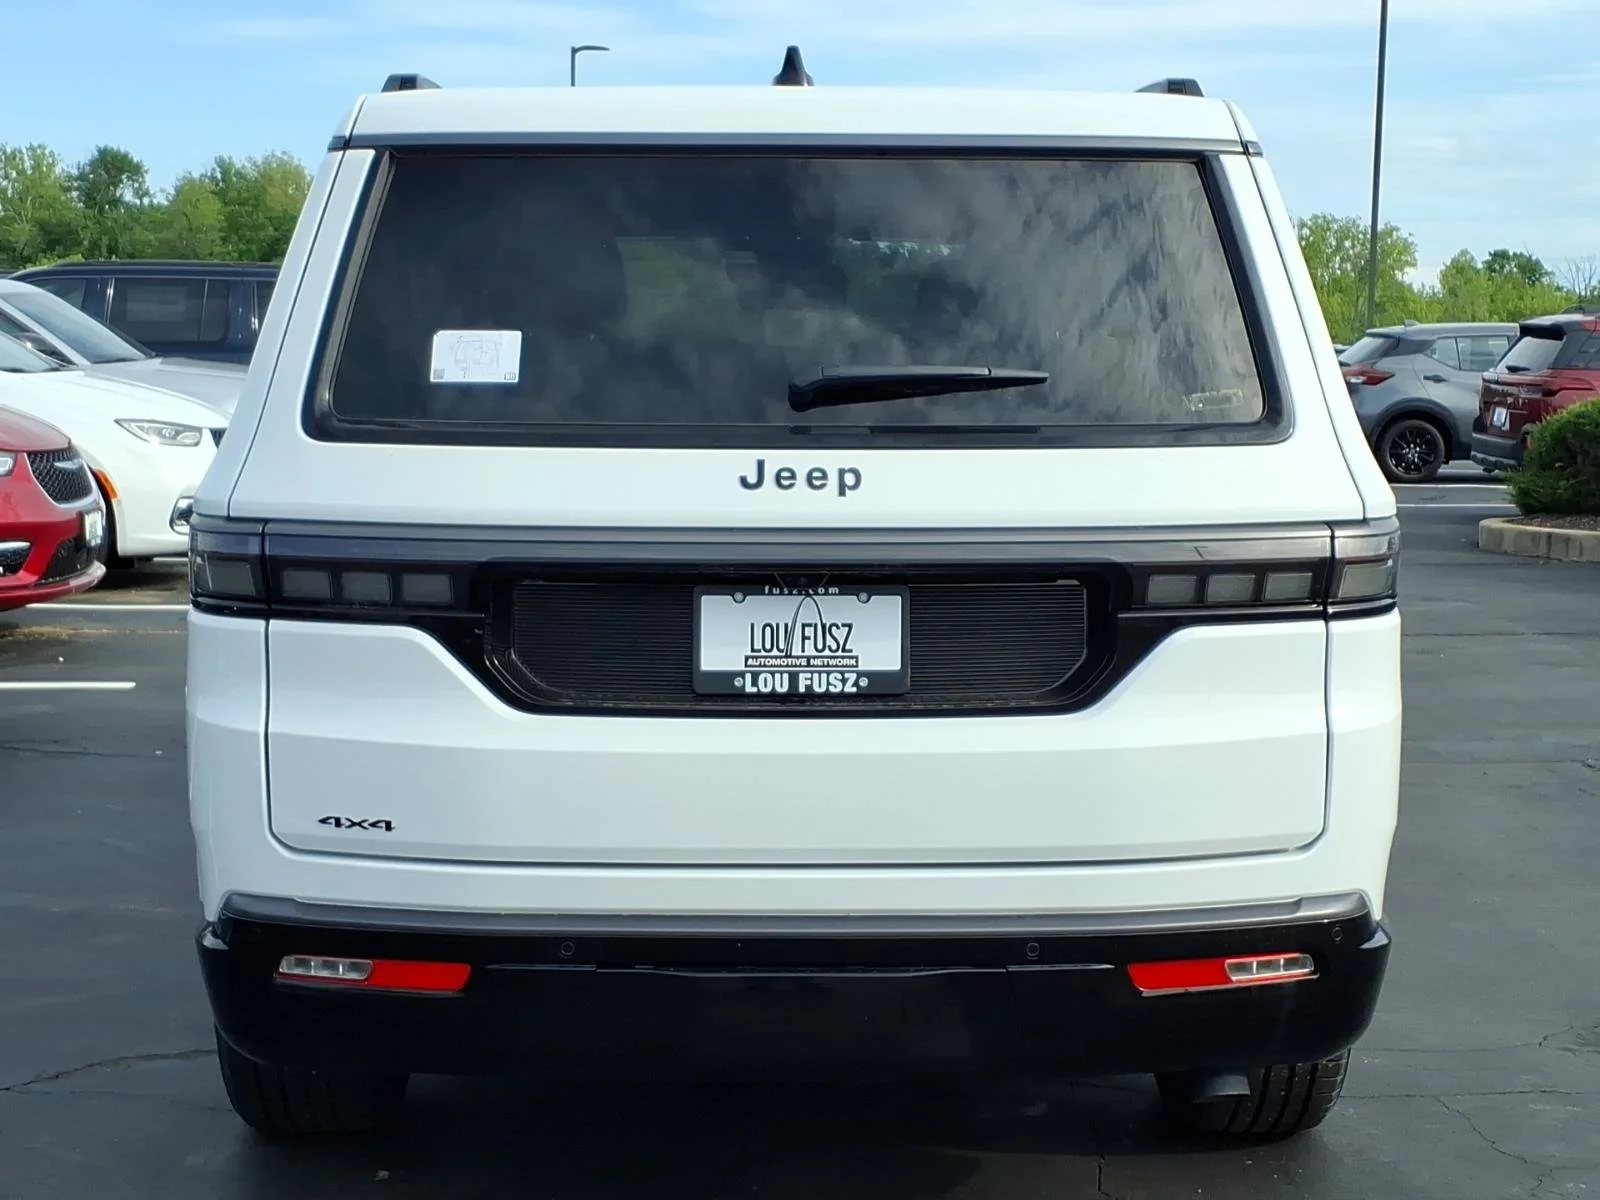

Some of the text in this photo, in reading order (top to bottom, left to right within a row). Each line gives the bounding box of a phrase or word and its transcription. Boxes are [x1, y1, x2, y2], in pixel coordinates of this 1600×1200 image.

[739, 458, 862, 497] Jeep
[750, 622, 853, 653] LOU FUSZ
[746, 658, 857, 667] AUTOMOTIVE NETWORK
[744, 672, 858, 693] LOU FUSZ
